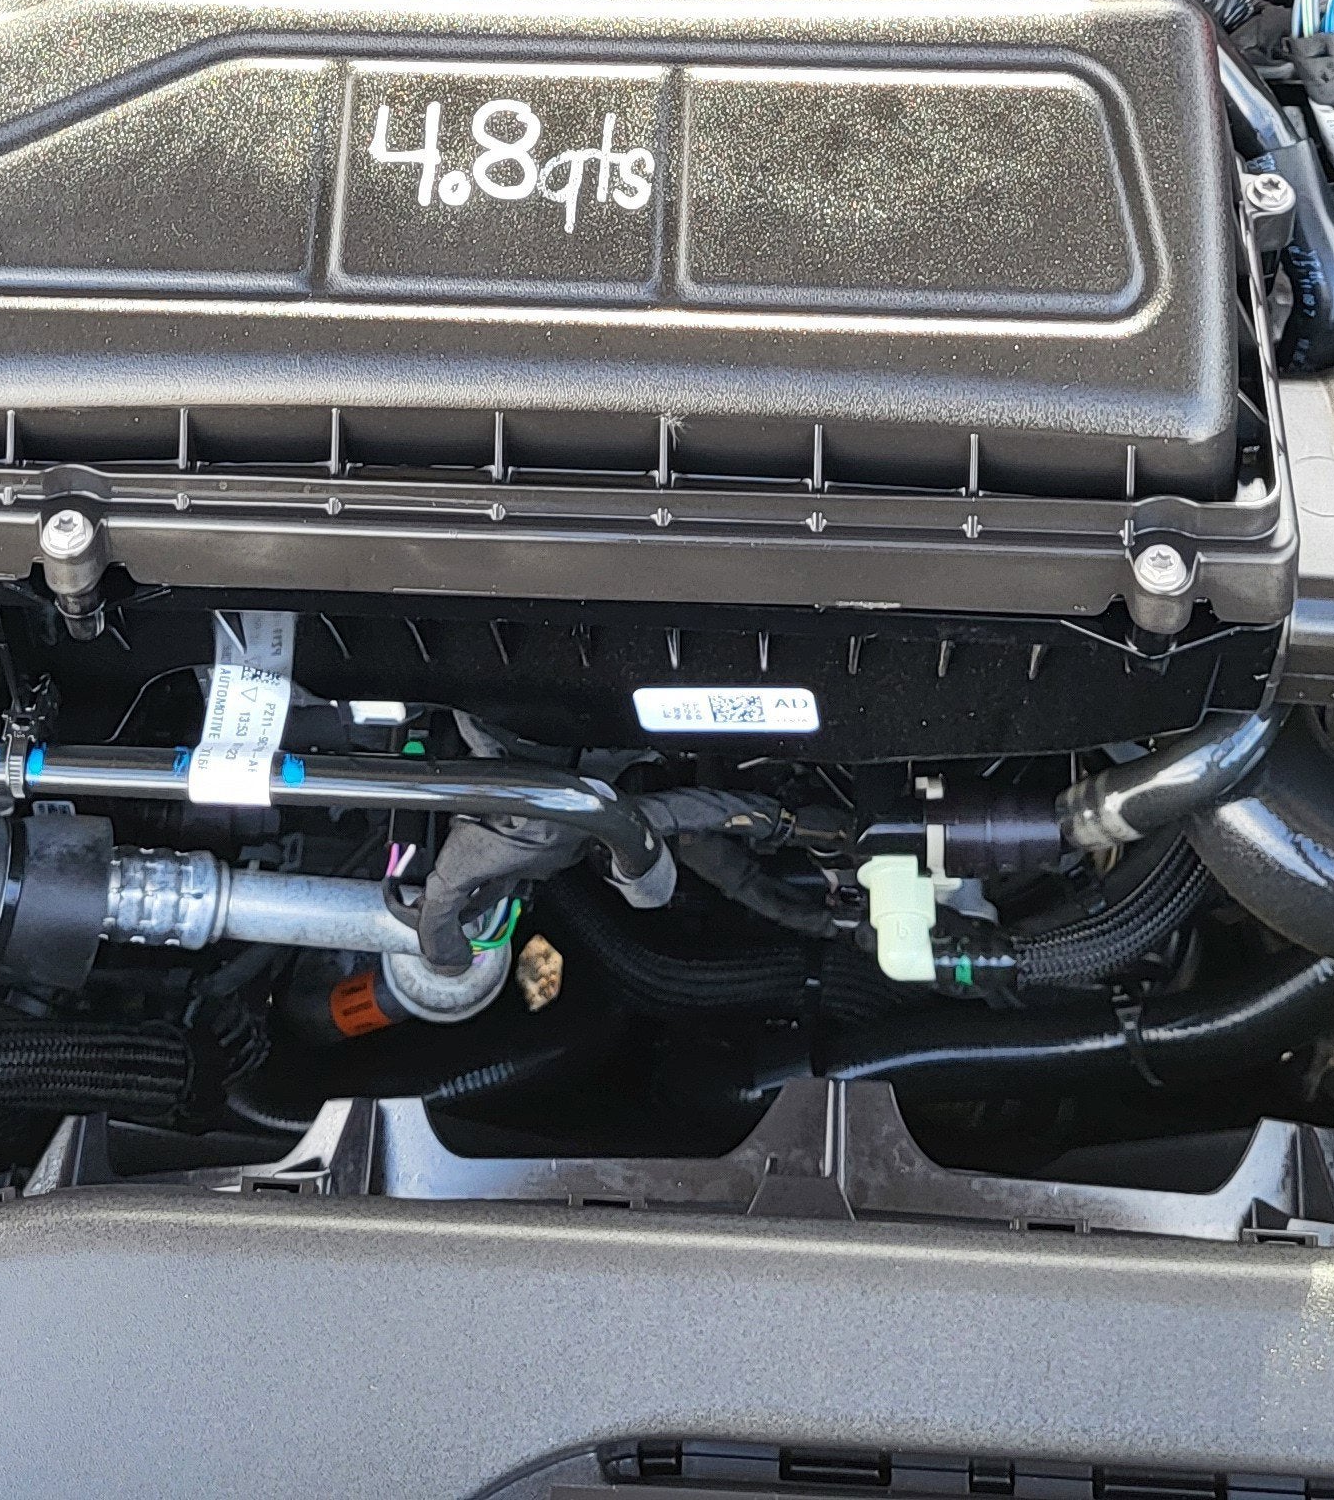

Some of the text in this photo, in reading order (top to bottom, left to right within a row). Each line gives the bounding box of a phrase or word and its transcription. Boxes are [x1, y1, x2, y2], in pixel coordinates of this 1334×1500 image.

[369, 99, 655, 234] 4.8qts
[209, 668, 231, 739] AUTOMOTIVE
[235, 712, 251, 737] 13:53
[774, 698, 809, 709] AD
